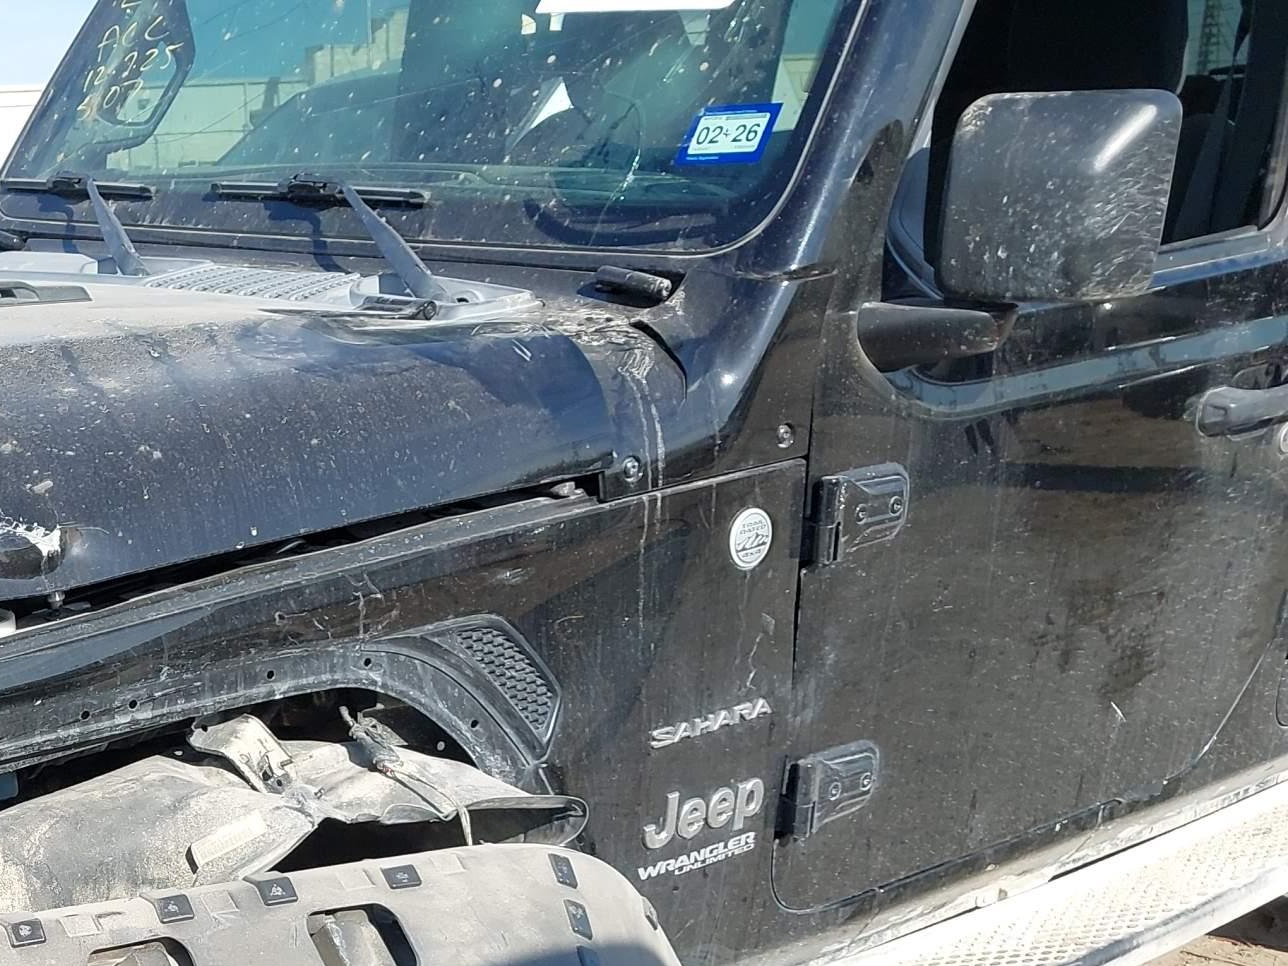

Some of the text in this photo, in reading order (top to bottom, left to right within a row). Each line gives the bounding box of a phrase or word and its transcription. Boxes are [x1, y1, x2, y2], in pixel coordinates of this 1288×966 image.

[730, 122, 762, 143] 26
[649, 697, 773, 749] SAHARA
[642, 777, 764, 849] Jeep
[637, 831, 756, 880] WRANGLER
[674, 843, 755, 875] UNLIMITED
